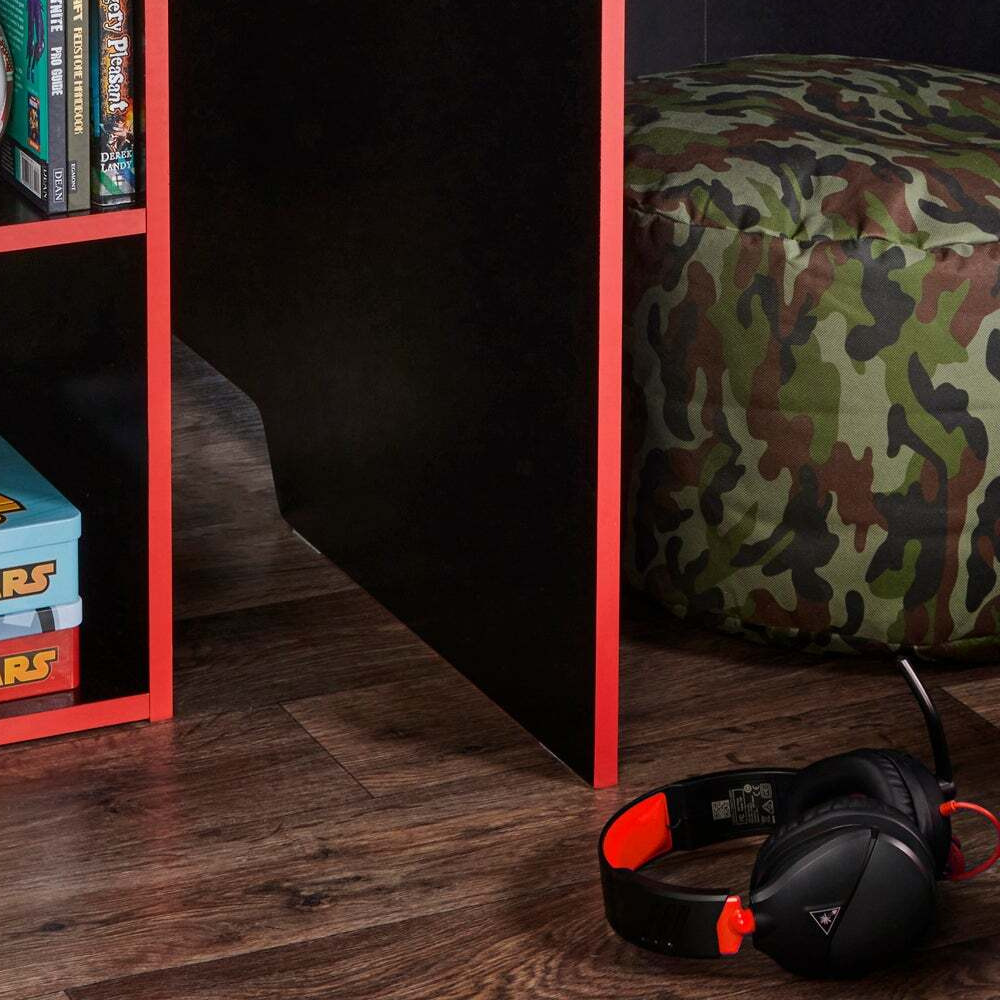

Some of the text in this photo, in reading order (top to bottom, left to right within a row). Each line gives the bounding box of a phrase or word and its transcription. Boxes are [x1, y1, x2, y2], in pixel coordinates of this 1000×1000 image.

[50, 46, 64, 97] PRO GUIDE
[73, 27, 84, 135] REDSTONE HANDBOOK
[107, 36, 129, 112] Pleasant
[100, 150, 133, 163] DEREK
[100, 160, 133, 172] LANDY
[54, 170, 63, 201] DEAN
